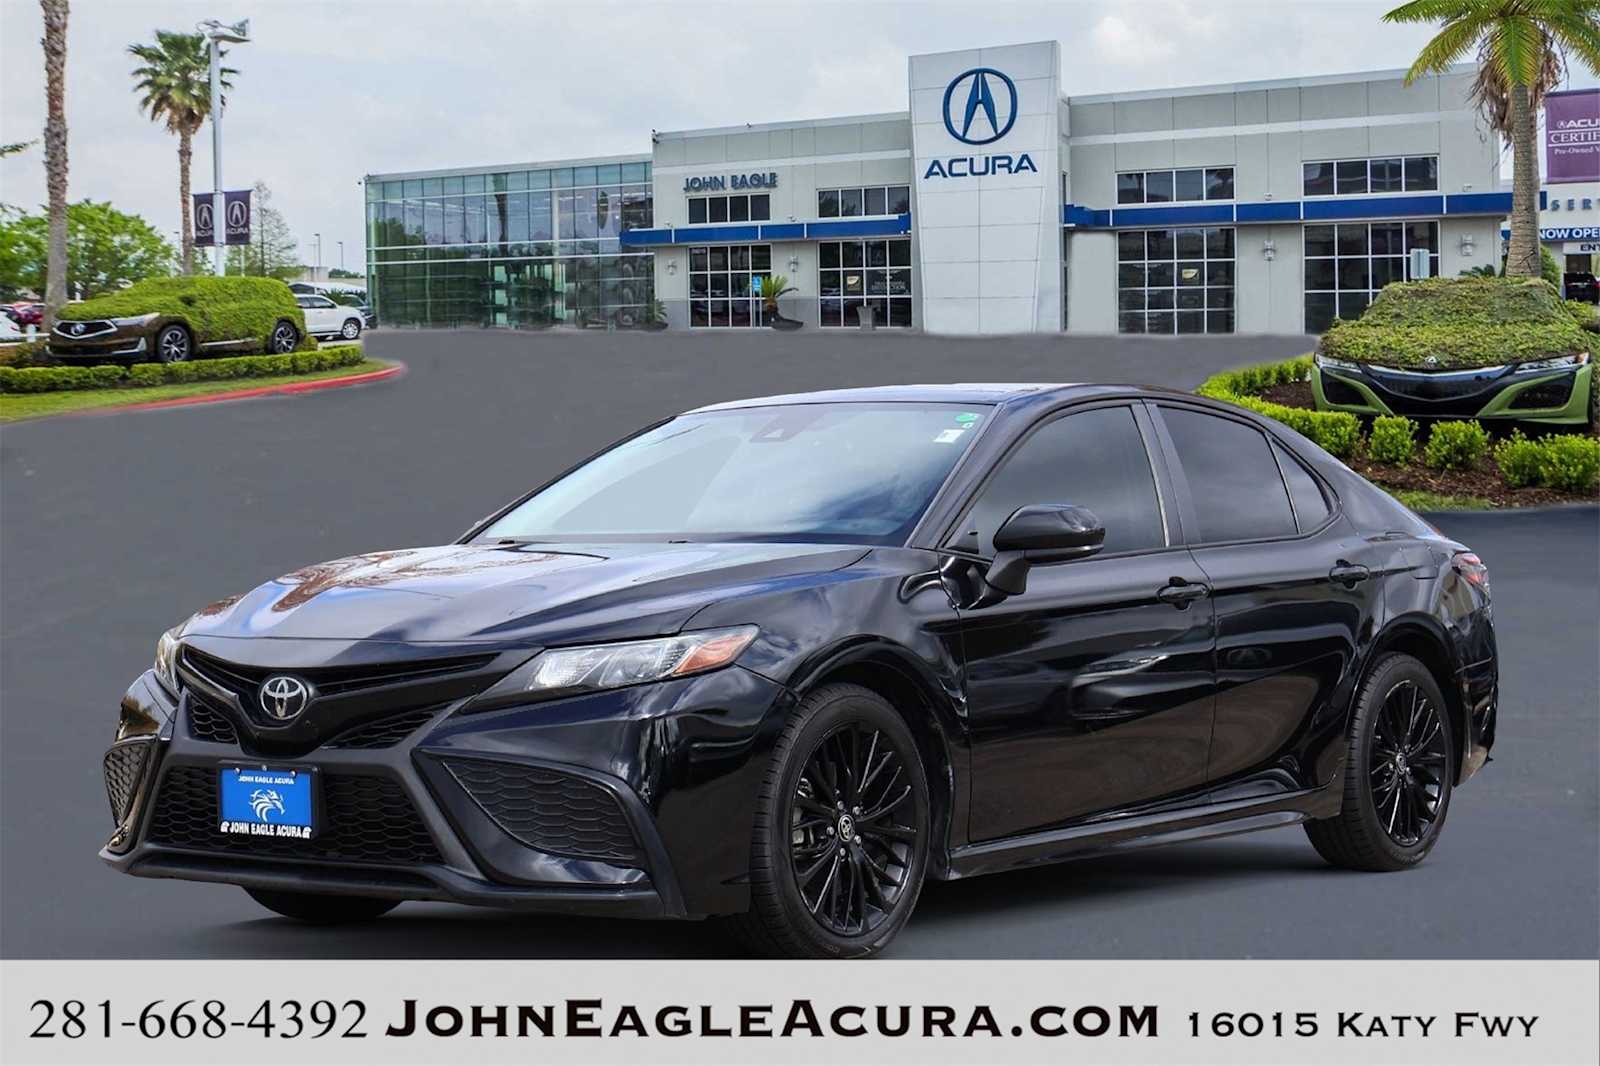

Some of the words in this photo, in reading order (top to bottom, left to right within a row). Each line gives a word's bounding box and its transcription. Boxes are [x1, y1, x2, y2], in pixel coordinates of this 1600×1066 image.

[924, 153, 1038, 179] ACURA
[683, 175, 726, 192] JOHN
[731, 171, 778, 190] EAGLE
[1572, 228, 1600, 238] OPE
[255, 776, 273, 784] EAGLE
[274, 777, 294, 785] ACURA
[230, 821, 250, 834] JOHN
[251, 823, 275, 836] EAGLE
[276, 825, 301, 838] ACURA
